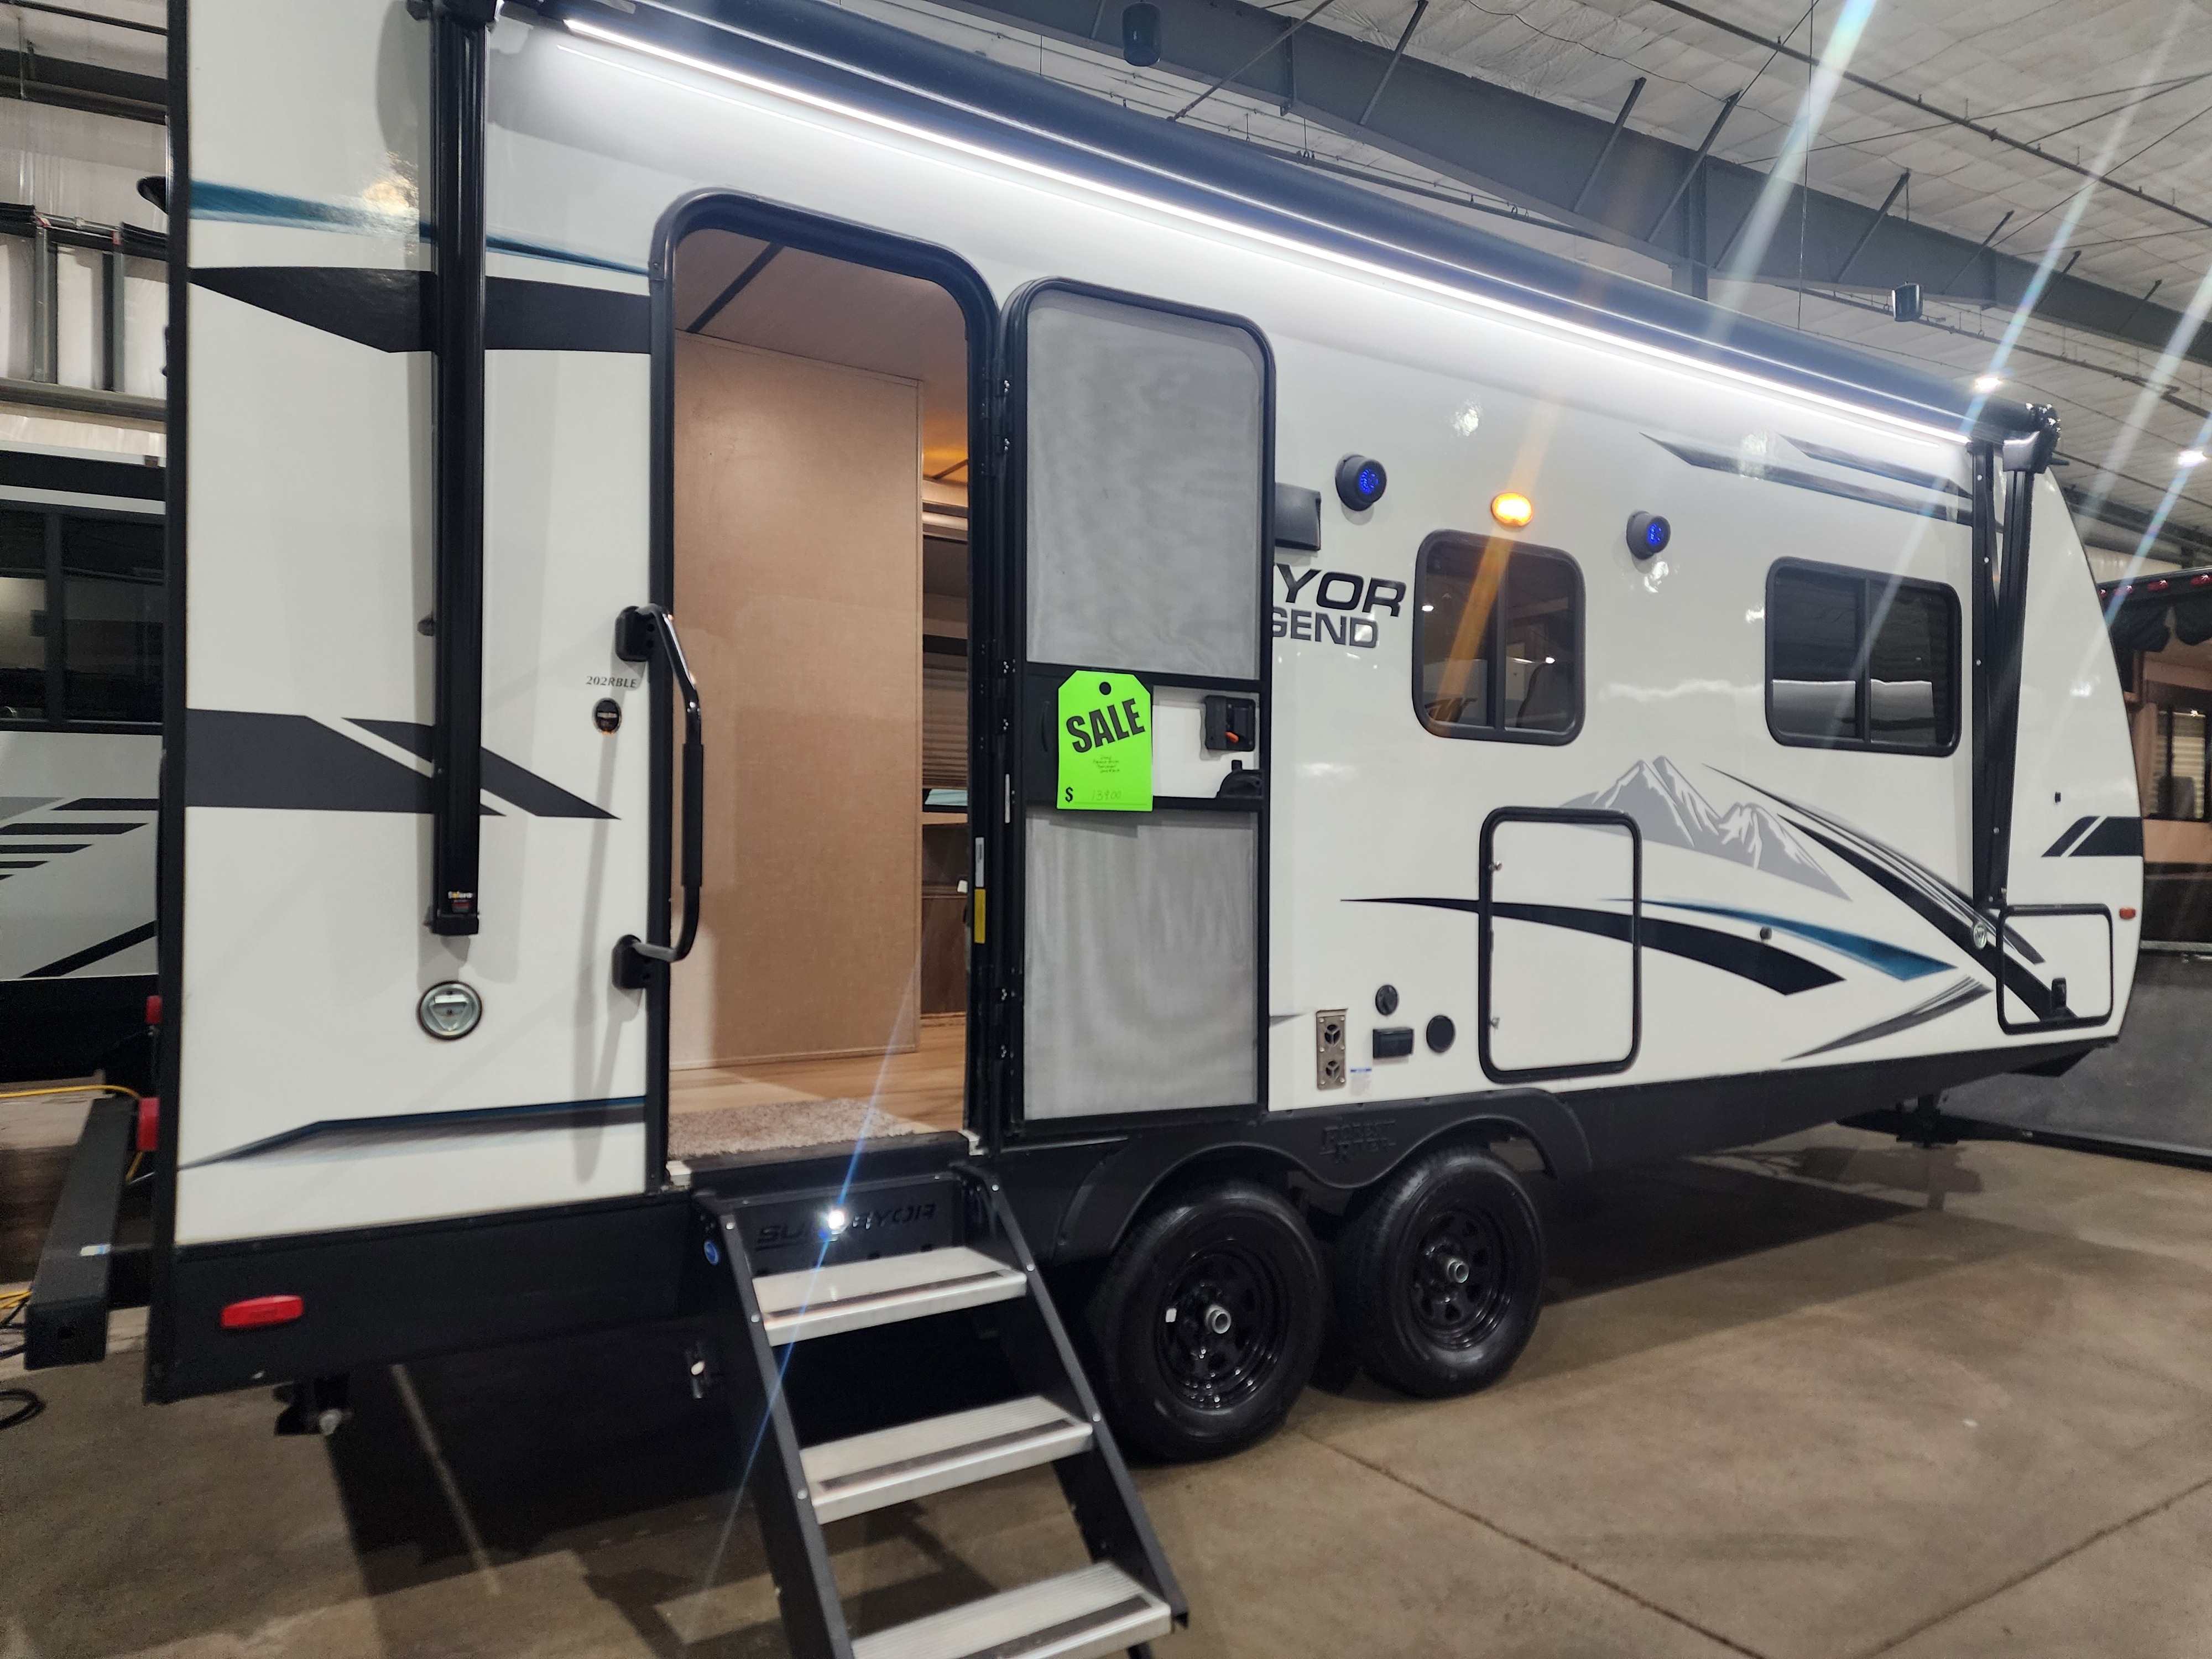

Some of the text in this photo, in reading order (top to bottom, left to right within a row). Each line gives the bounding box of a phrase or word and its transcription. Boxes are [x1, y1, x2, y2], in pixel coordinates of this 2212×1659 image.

[586, 676, 637, 688] 202RBLE
[1066, 698, 1145, 753] SALE
[1065, 787, 1073, 802] $
[757, 1203, 937, 1244] SUYOR
